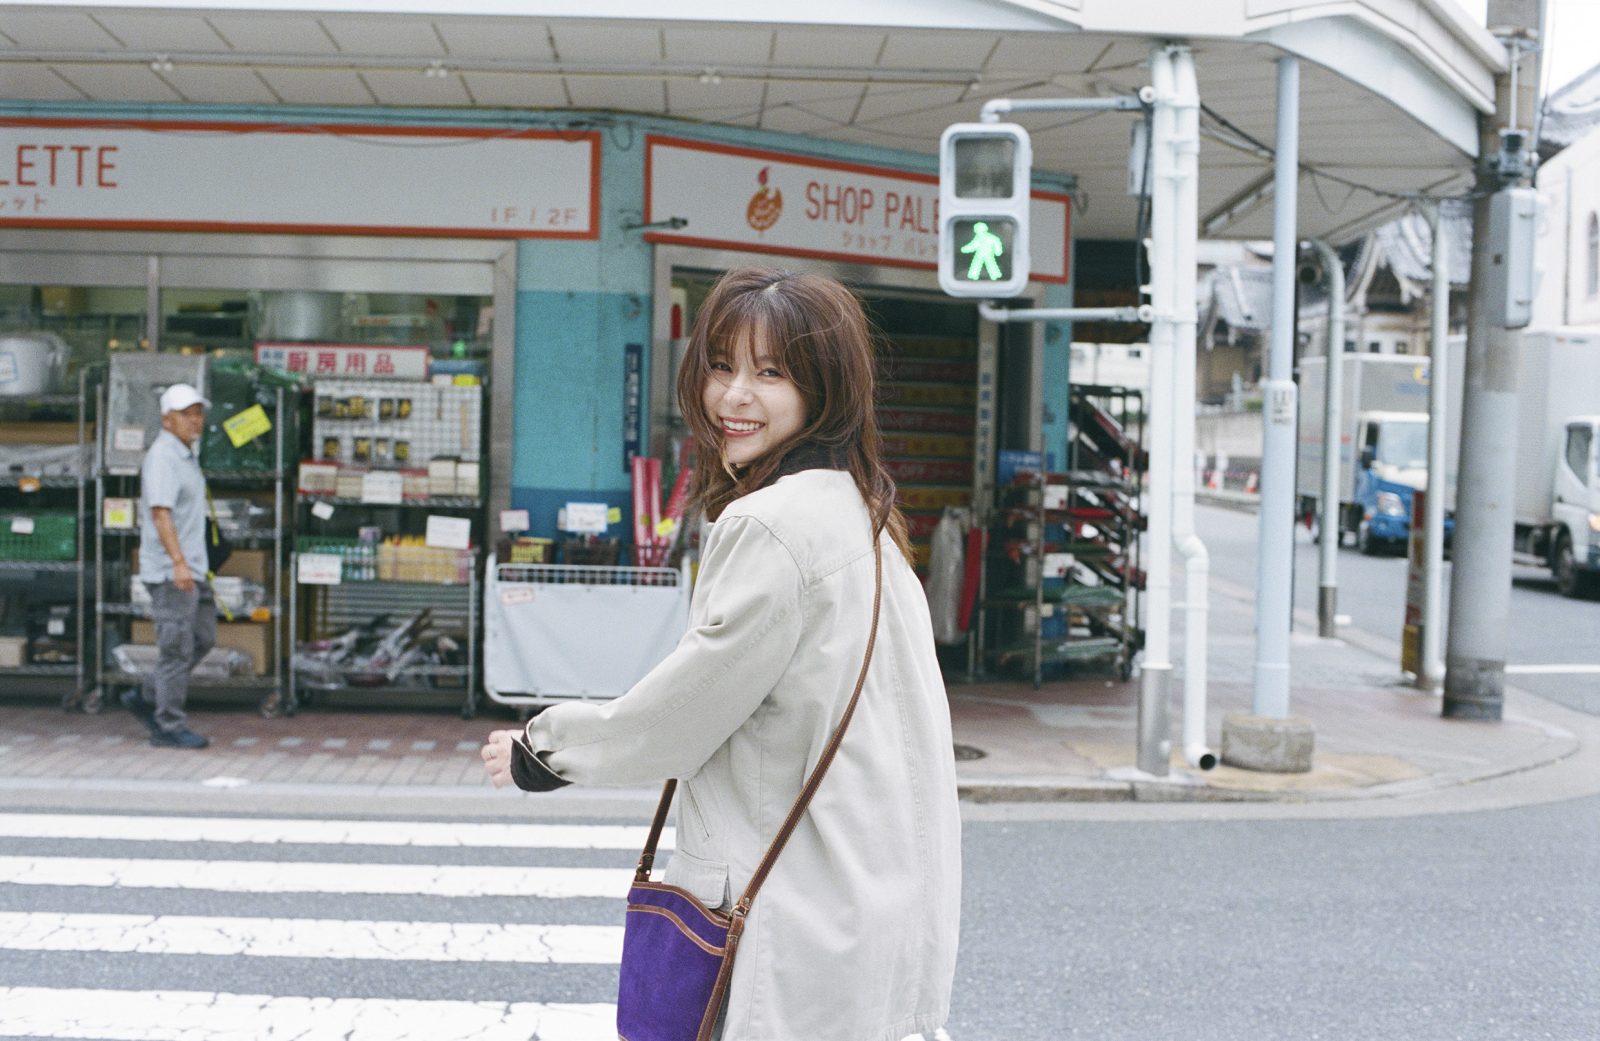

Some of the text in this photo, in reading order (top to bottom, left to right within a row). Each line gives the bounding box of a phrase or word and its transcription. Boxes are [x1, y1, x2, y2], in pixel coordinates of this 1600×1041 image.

[0, 145, 118, 187] ETTE
[547, 208, 576, 225] 2F
[806, 181, 874, 224] SHOP
